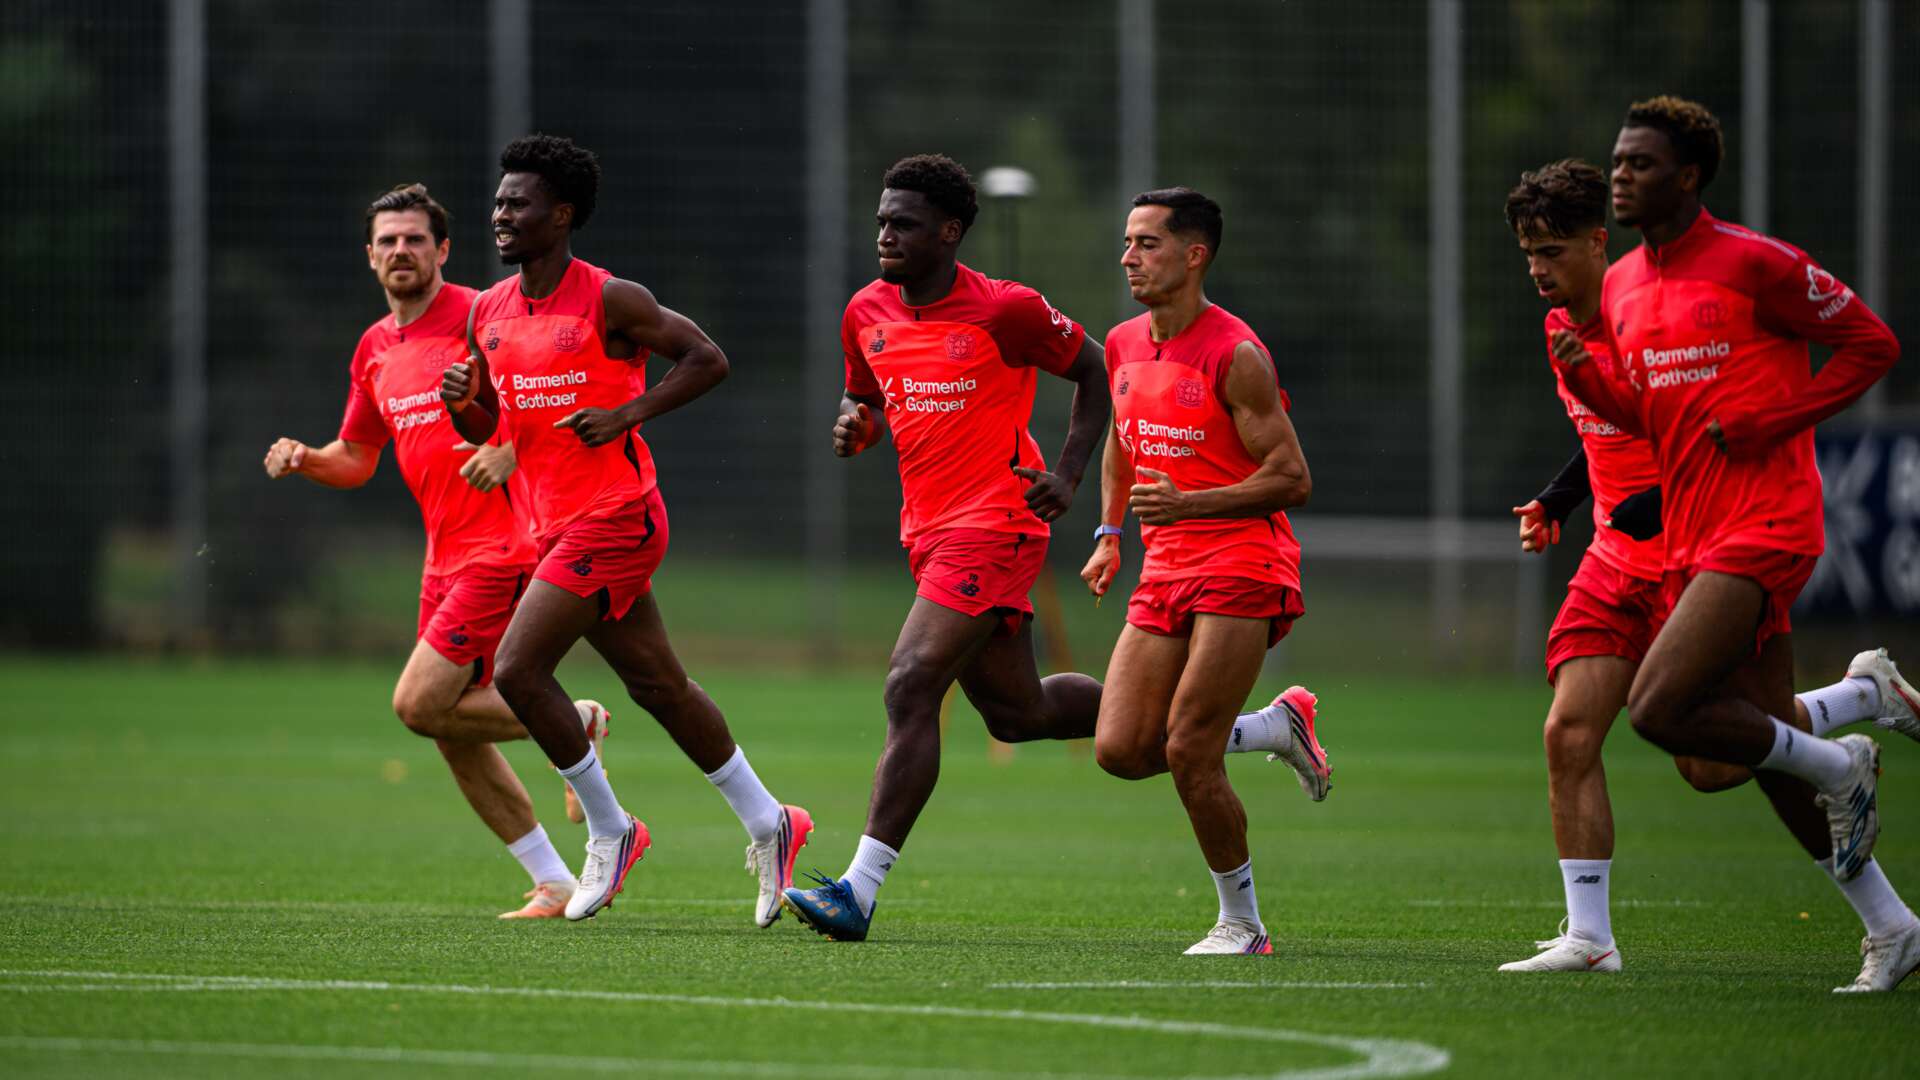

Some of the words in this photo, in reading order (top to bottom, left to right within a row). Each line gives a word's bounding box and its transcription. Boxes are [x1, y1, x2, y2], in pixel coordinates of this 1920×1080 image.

[1642, 340, 1730, 367] Barmenia
[512, 369, 587, 391] Barmenia
[902, 377, 977, 394] Barmenia
[1647, 364, 1720, 389] Gothaer
[387, 386, 441, 414] Barmeni
[515, 391, 577, 409] Gothaer
[905, 397, 966, 413] Gothaer
[1137, 418, 1205, 441] Barmenia
